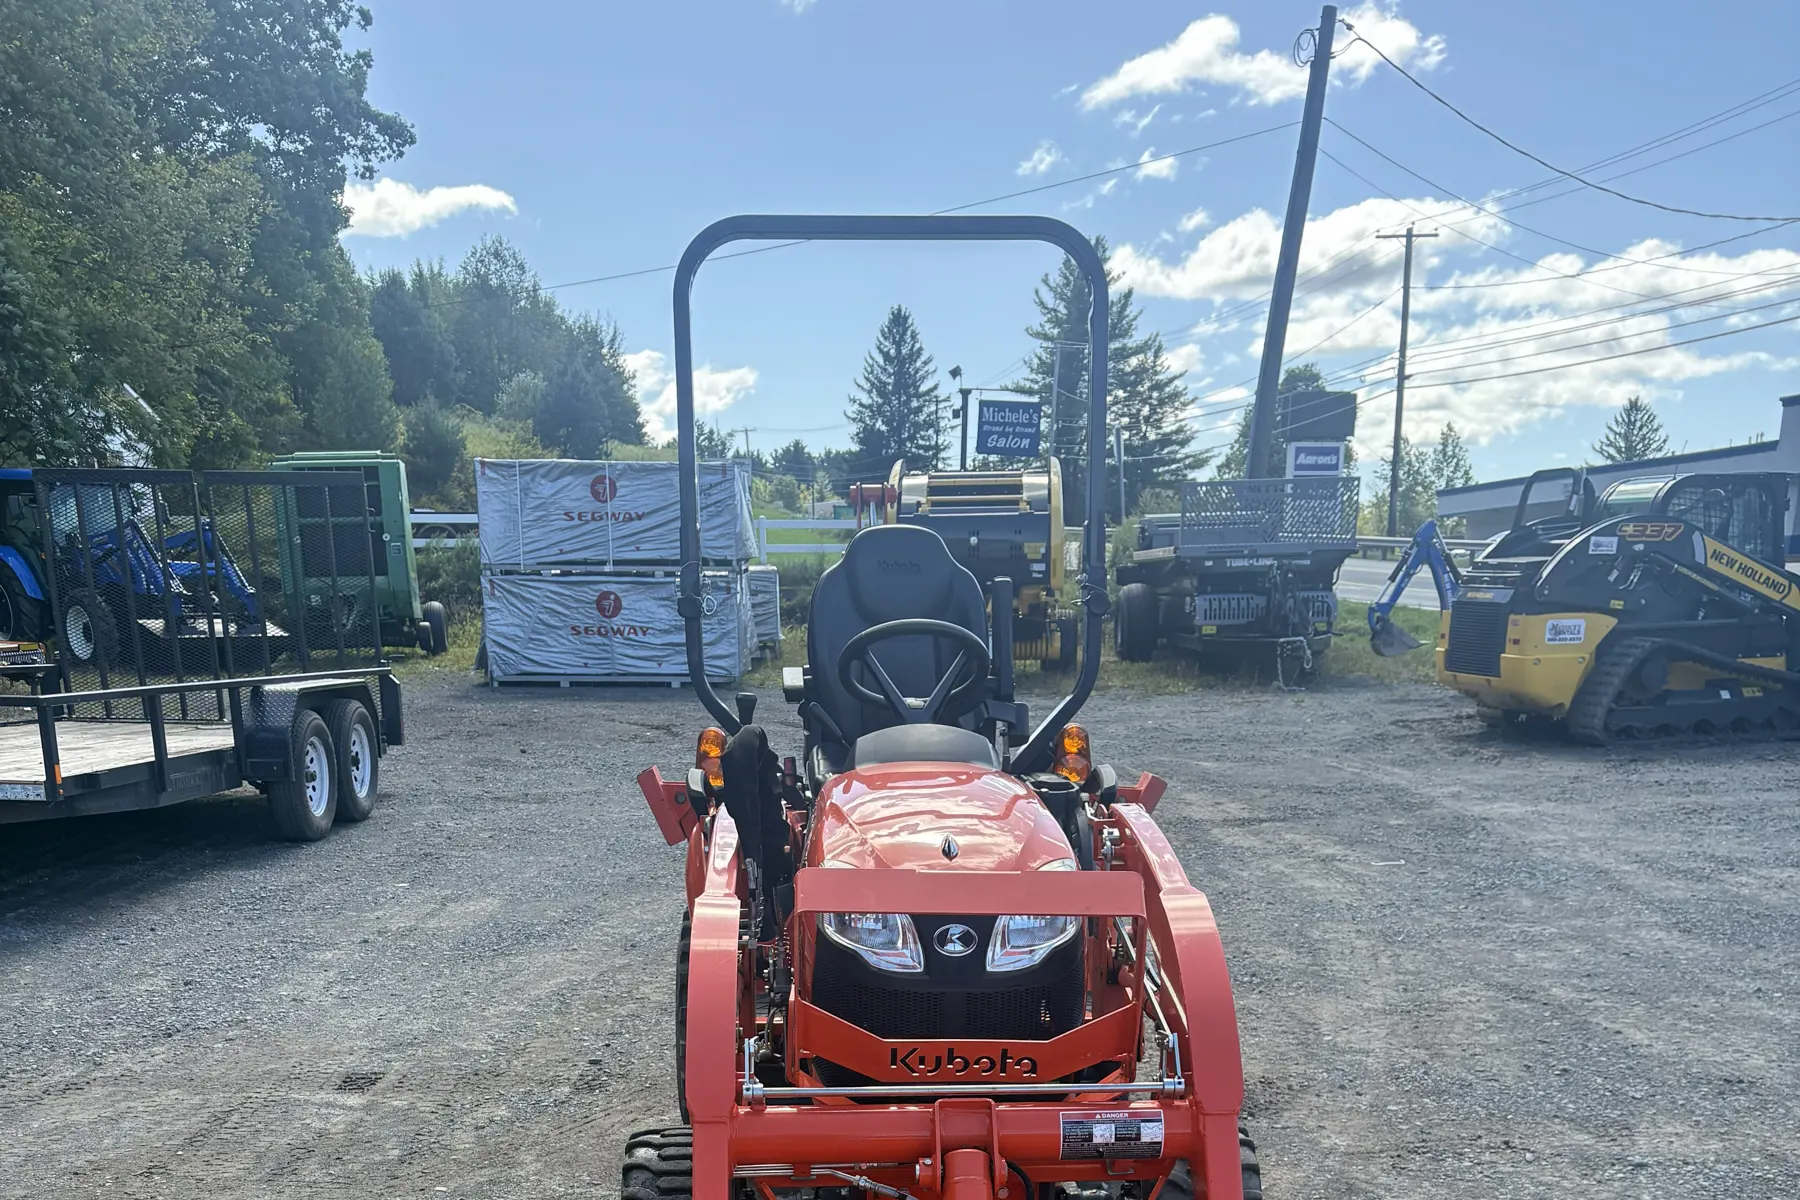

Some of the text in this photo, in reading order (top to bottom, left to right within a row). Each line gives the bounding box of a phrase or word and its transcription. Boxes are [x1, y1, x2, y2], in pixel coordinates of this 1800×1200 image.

[982, 407, 1039, 423] Michele's
[987, 434, 1031, 448] Salon
[1296, 453, 1338, 464] Aaron's
[563, 511, 646, 522] SEGWAY
[1710, 548, 1738, 570] NEW
[1737, 561, 1787, 595] HOLLAND
[569, 625, 650, 637] SEGWAY
[890, 1047, 1038, 1077] Kubota
